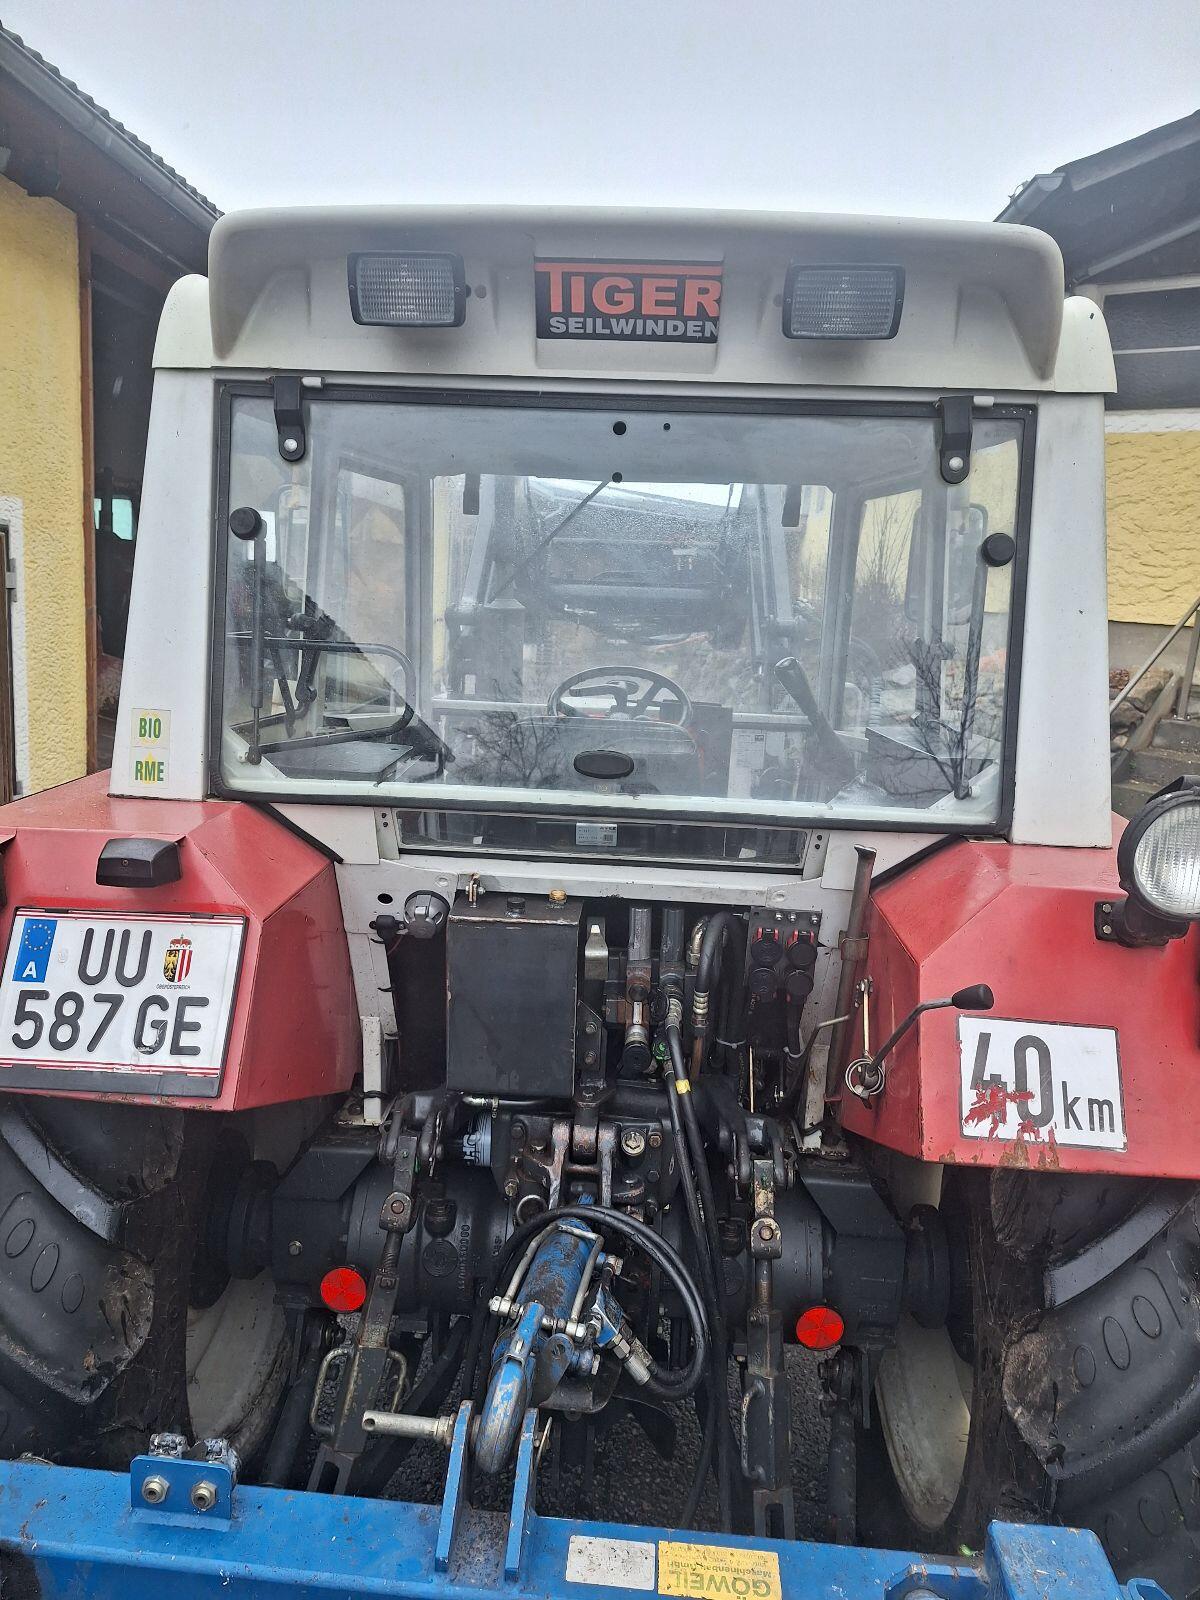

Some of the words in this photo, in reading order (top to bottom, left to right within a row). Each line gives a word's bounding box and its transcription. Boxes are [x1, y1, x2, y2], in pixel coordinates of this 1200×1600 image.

[535, 262, 722, 317] TIGER
[549, 317, 720, 337] SEILWINDEN
[139, 717, 162, 738] BIO
[134, 760, 165, 782] RME
[22, 961, 37, 979] A
[78, 927, 153, 988] UU
[12, 989, 125, 1053] 587
[133, 994, 210, 1056] GE
[969, 1032, 1054, 1128] 40
[1061, 1080, 1116, 1133] km
